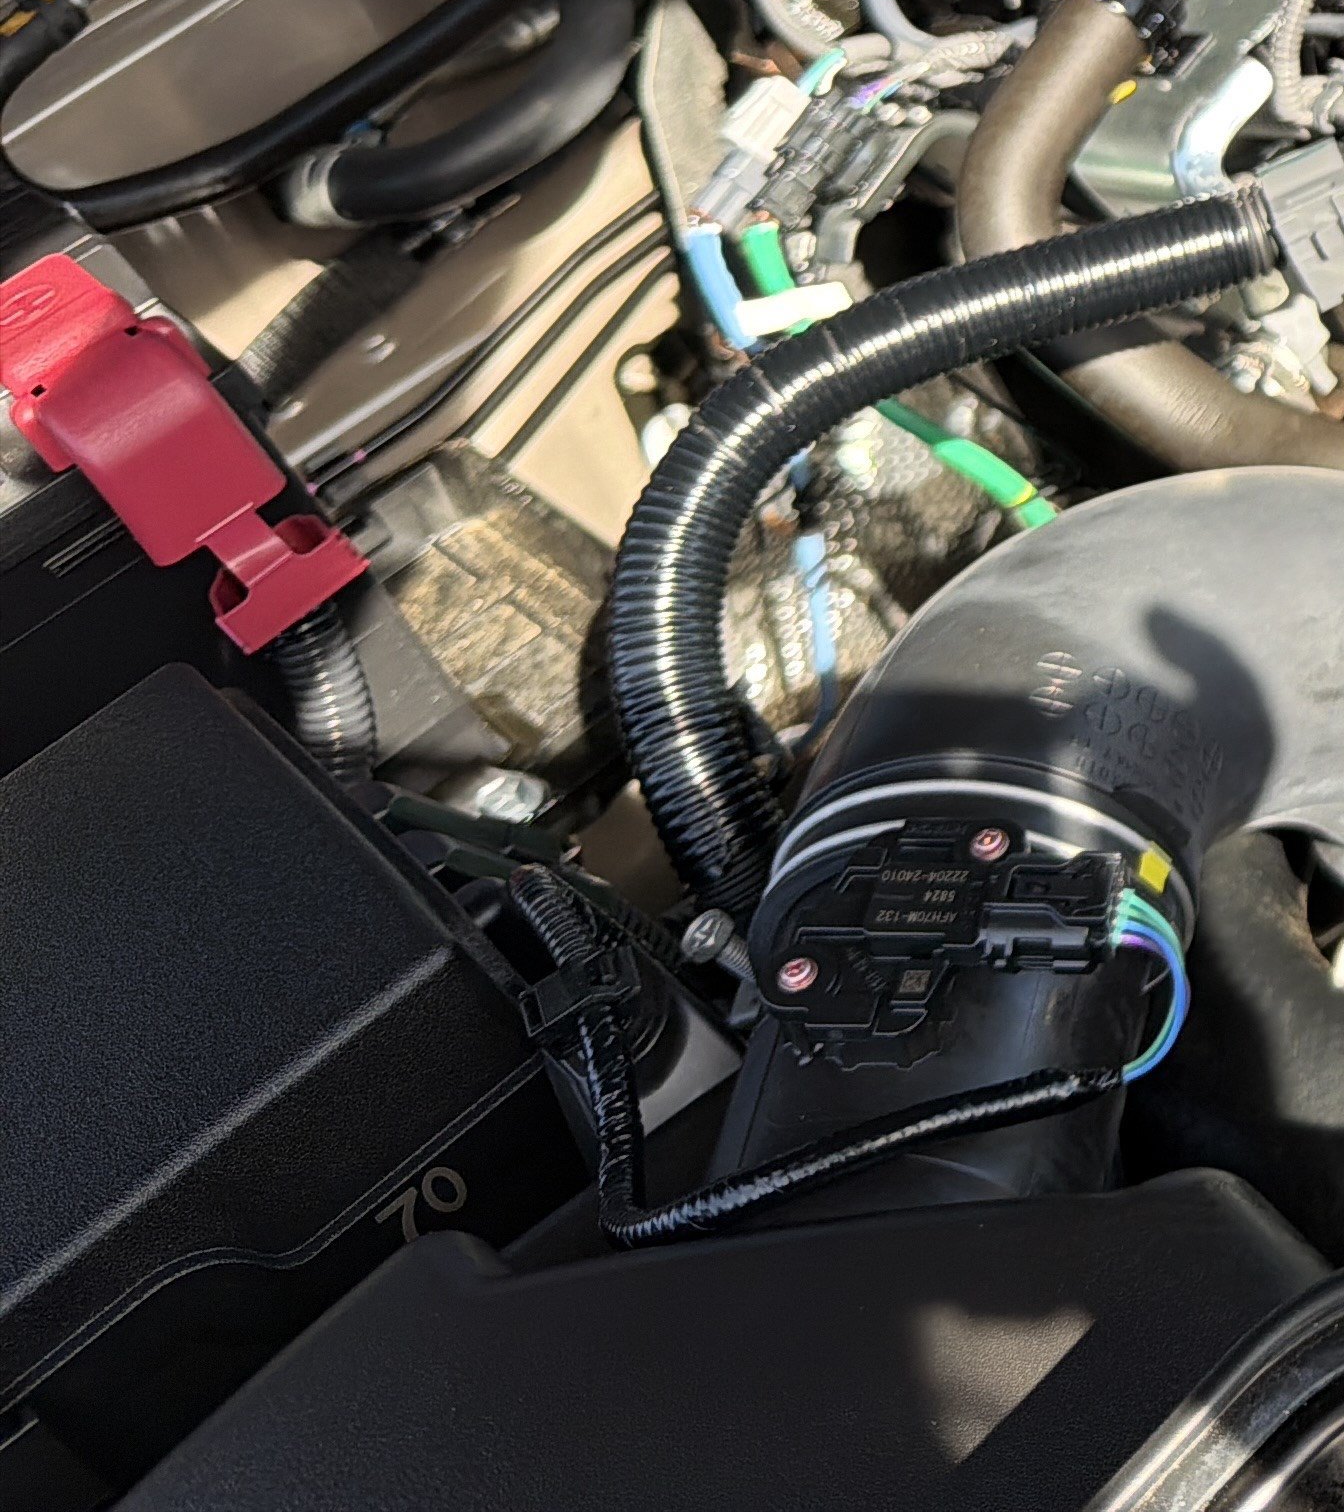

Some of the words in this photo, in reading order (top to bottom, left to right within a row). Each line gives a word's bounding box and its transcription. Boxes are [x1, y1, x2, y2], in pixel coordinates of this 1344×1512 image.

[881, 868, 970, 883] 22204-24010
[922, 889, 956, 903] 5824
[373, 1166, 468, 1243] 70
